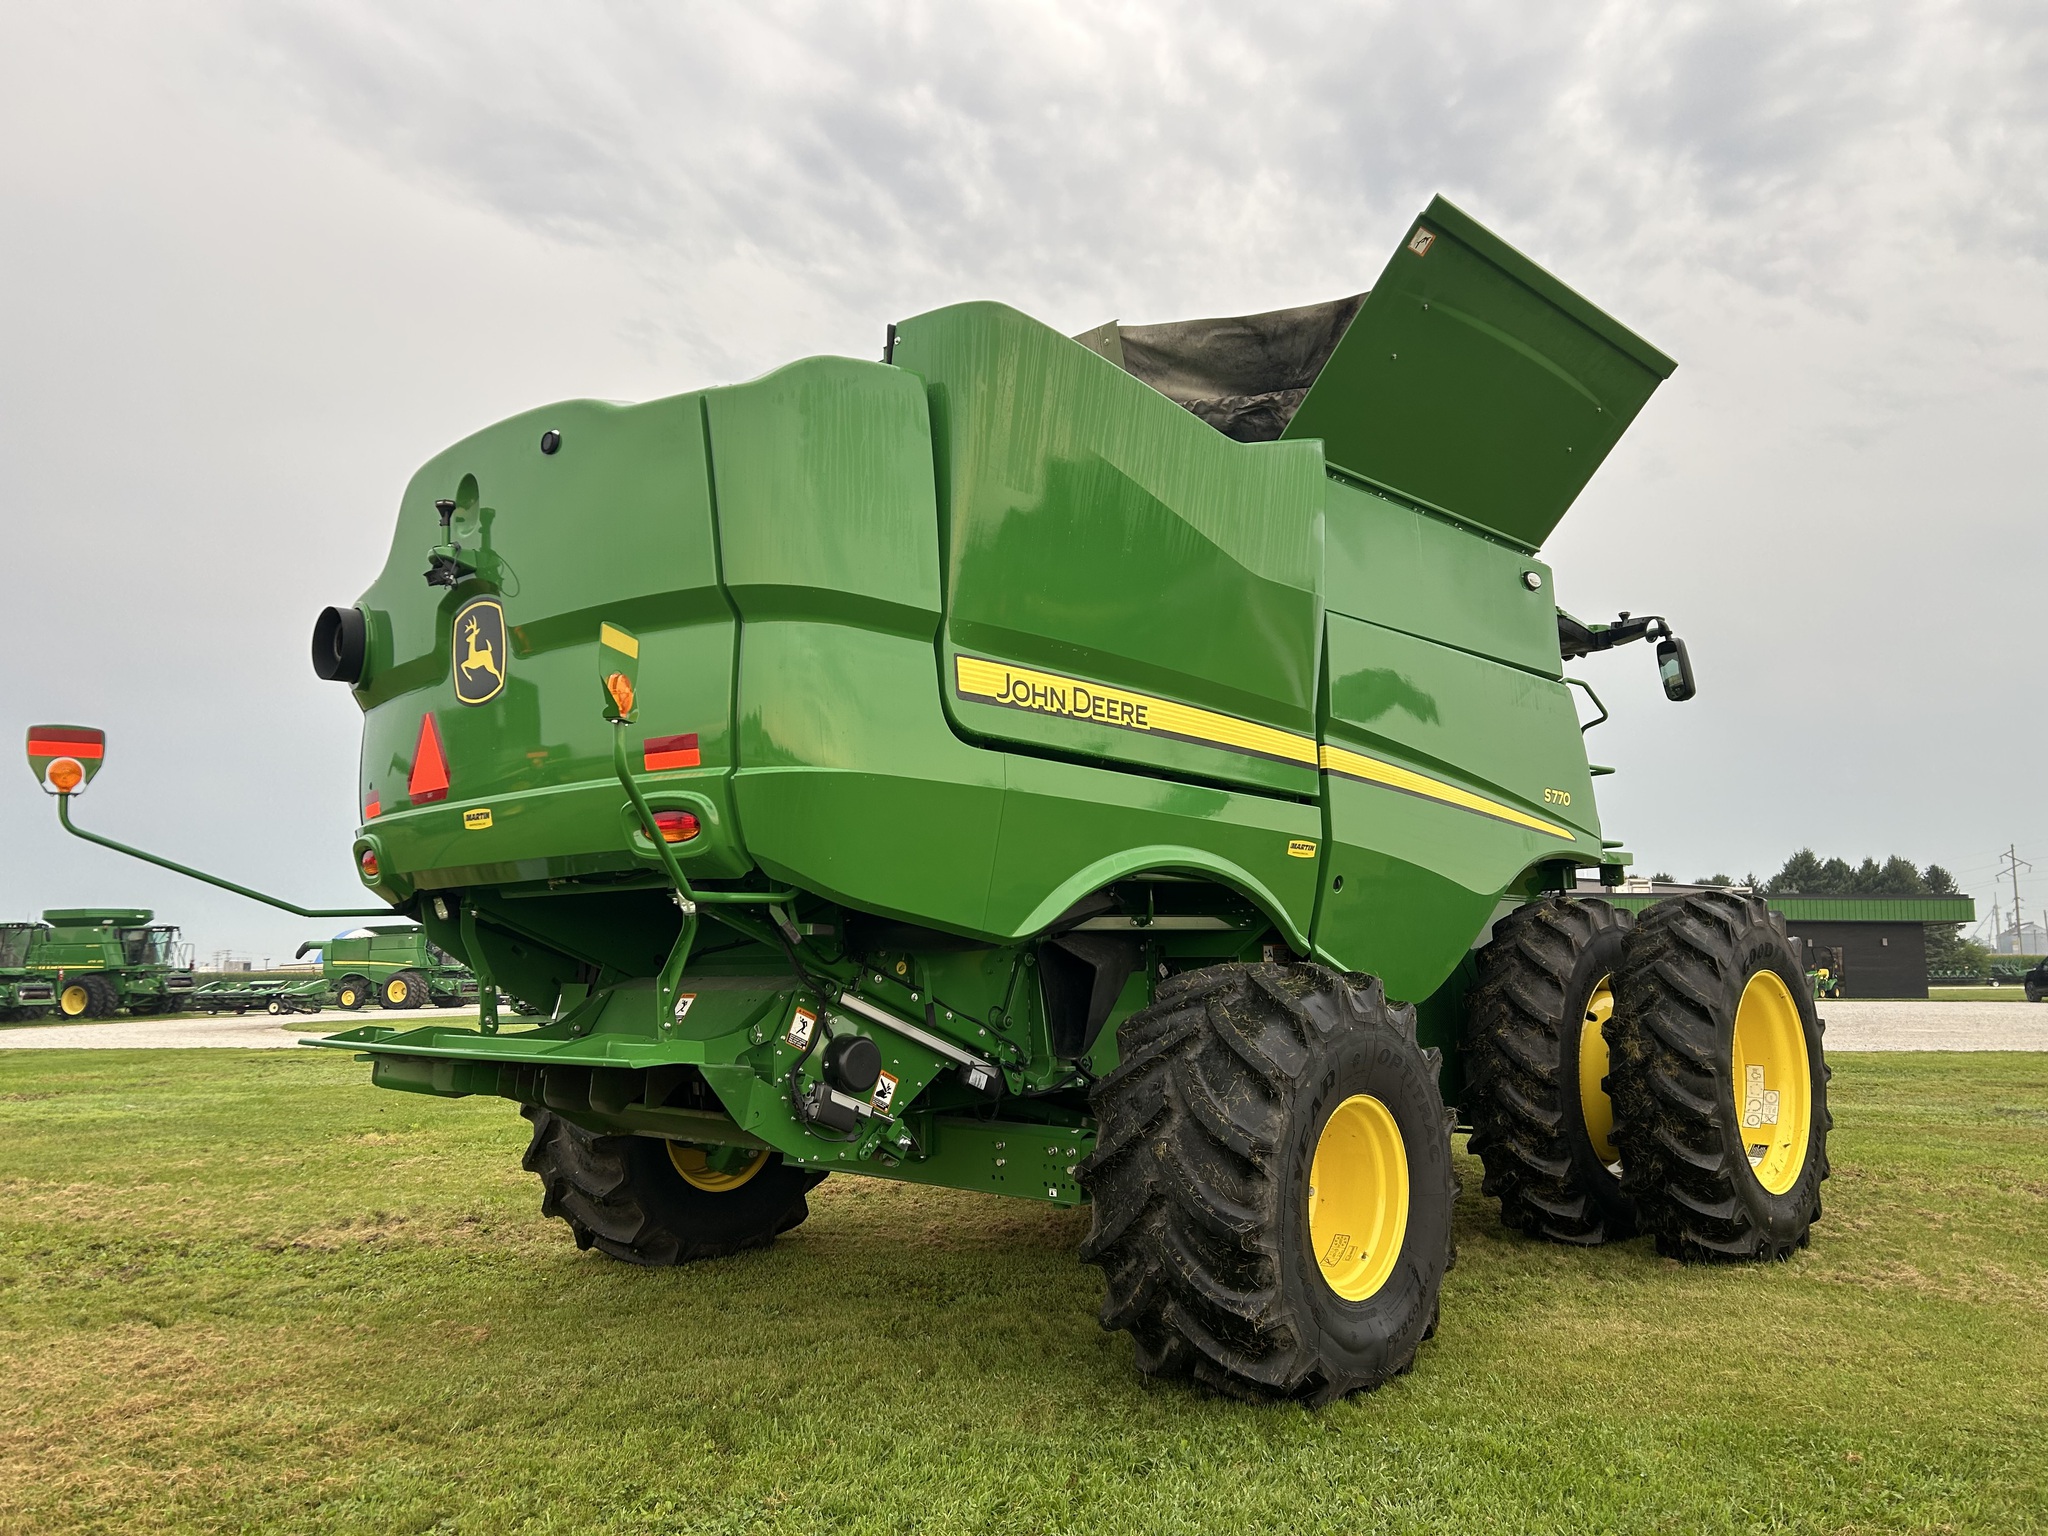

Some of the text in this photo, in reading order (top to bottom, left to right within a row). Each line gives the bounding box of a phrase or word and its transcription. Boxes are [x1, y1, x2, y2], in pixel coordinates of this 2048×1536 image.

[1544, 787, 1571, 807] S770
[465, 812, 490, 821] MARTIN
[1290, 842, 1315, 851] MARTIN
[1377, 1048, 1440, 1163] OPTITRAC
